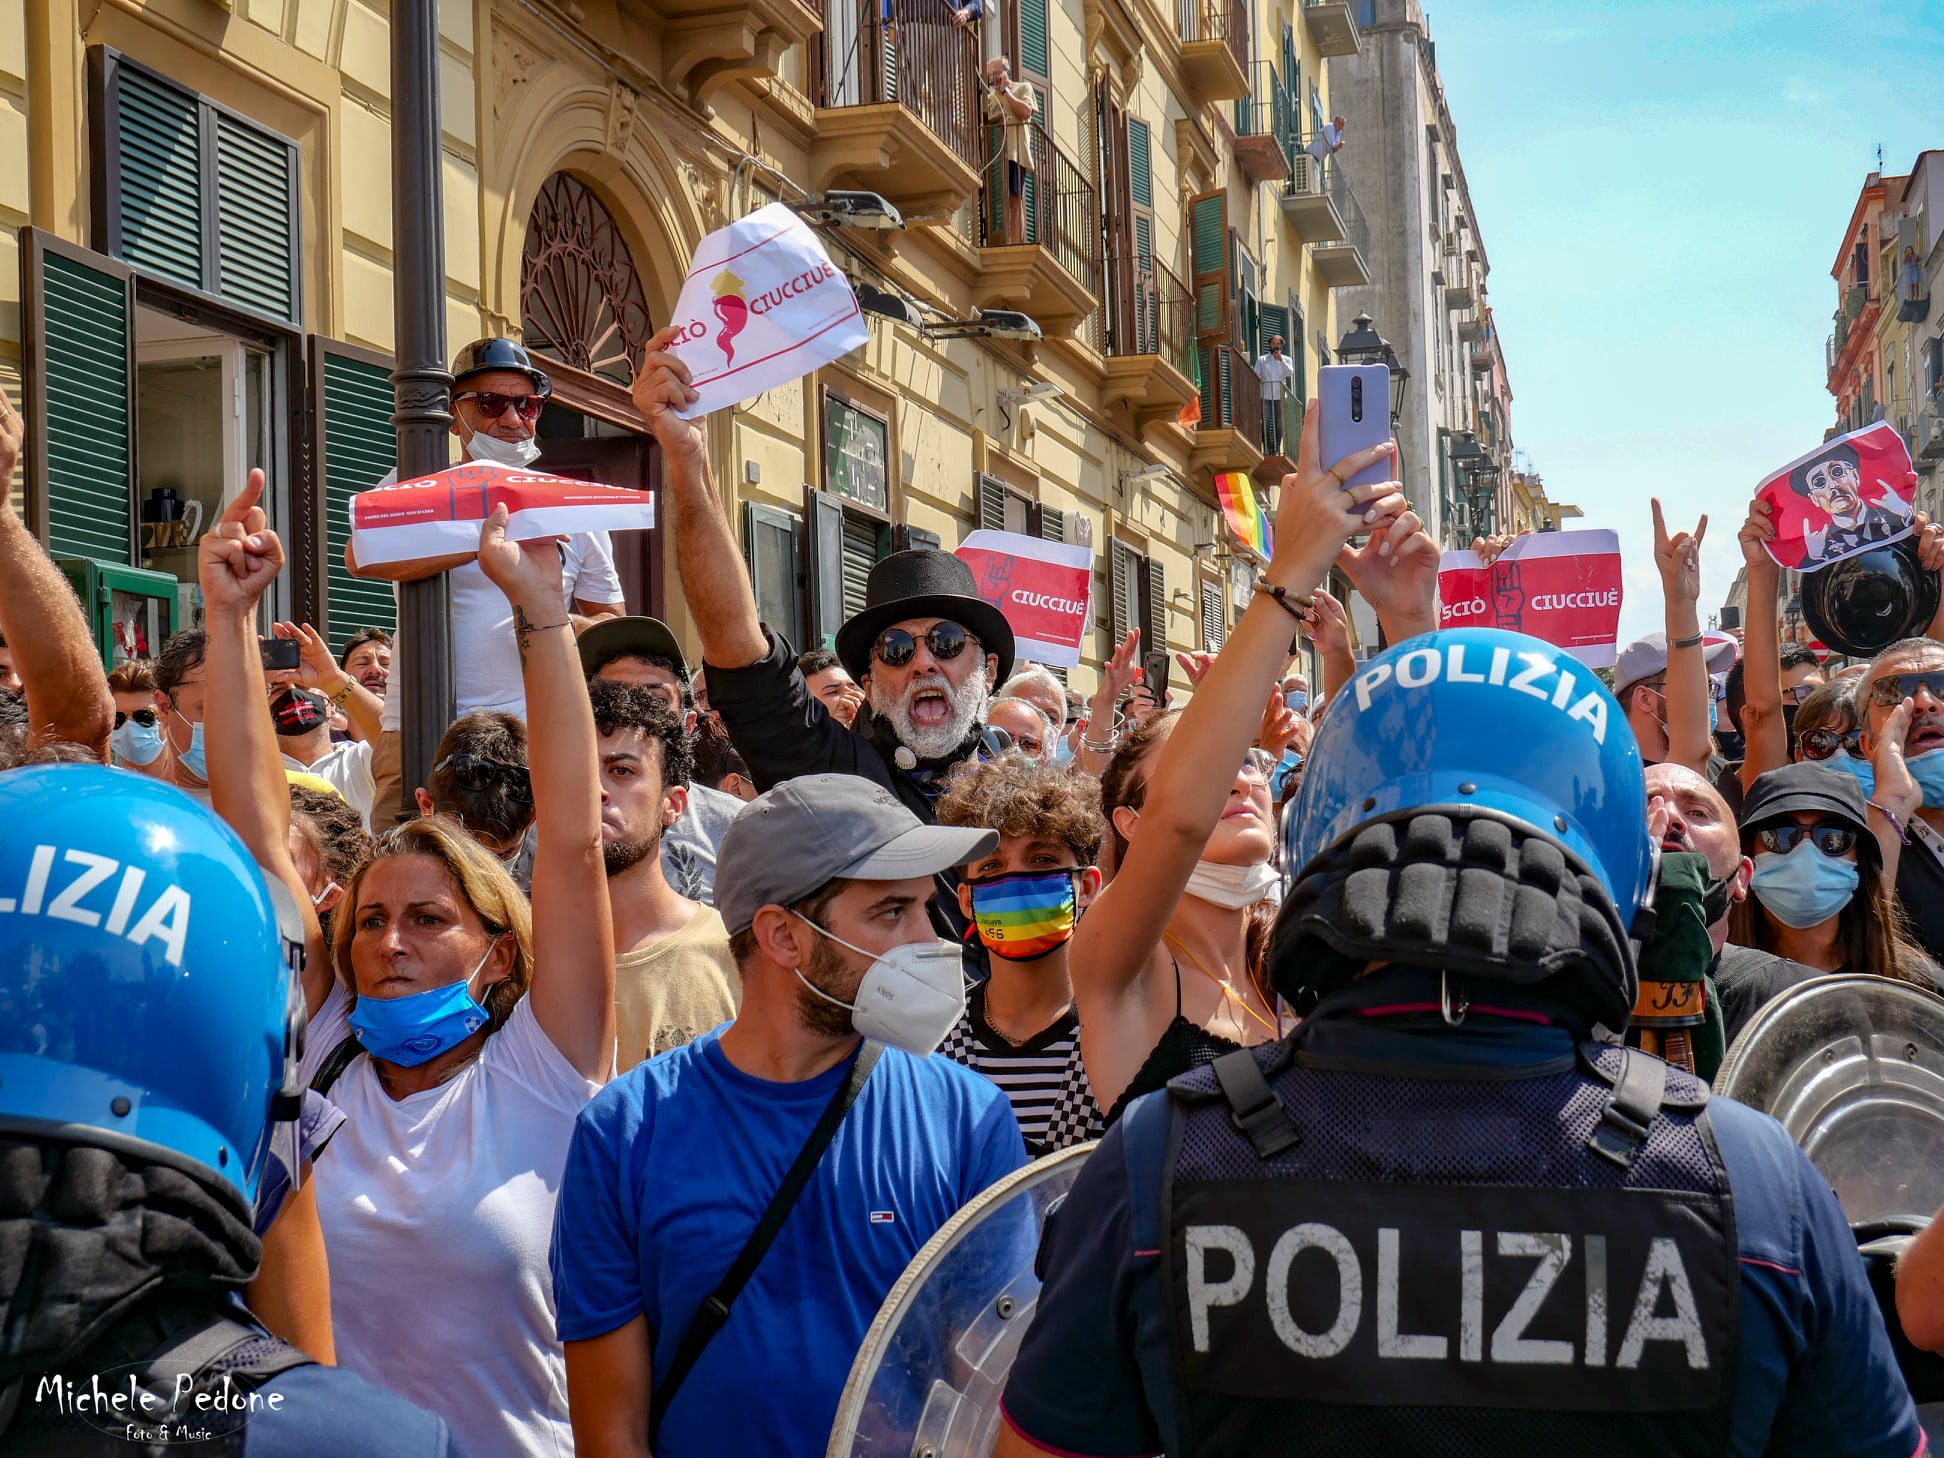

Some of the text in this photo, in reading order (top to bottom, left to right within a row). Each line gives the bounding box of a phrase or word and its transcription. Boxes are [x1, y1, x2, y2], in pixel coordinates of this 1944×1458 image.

[664, 259, 836, 351] CIÒ CIUCCIUÈ
[505, 475, 639, 492] CIUCCIU
[1011, 589, 1085, 615] CIUCCIUÈ
[1531, 588, 1618, 611] CIUCCIUÈ
[1354, 644, 1608, 745] POLIZIA
[877, 986, 895, 1001] KN95
[1185, 1221, 1710, 1369] POLIZIA
